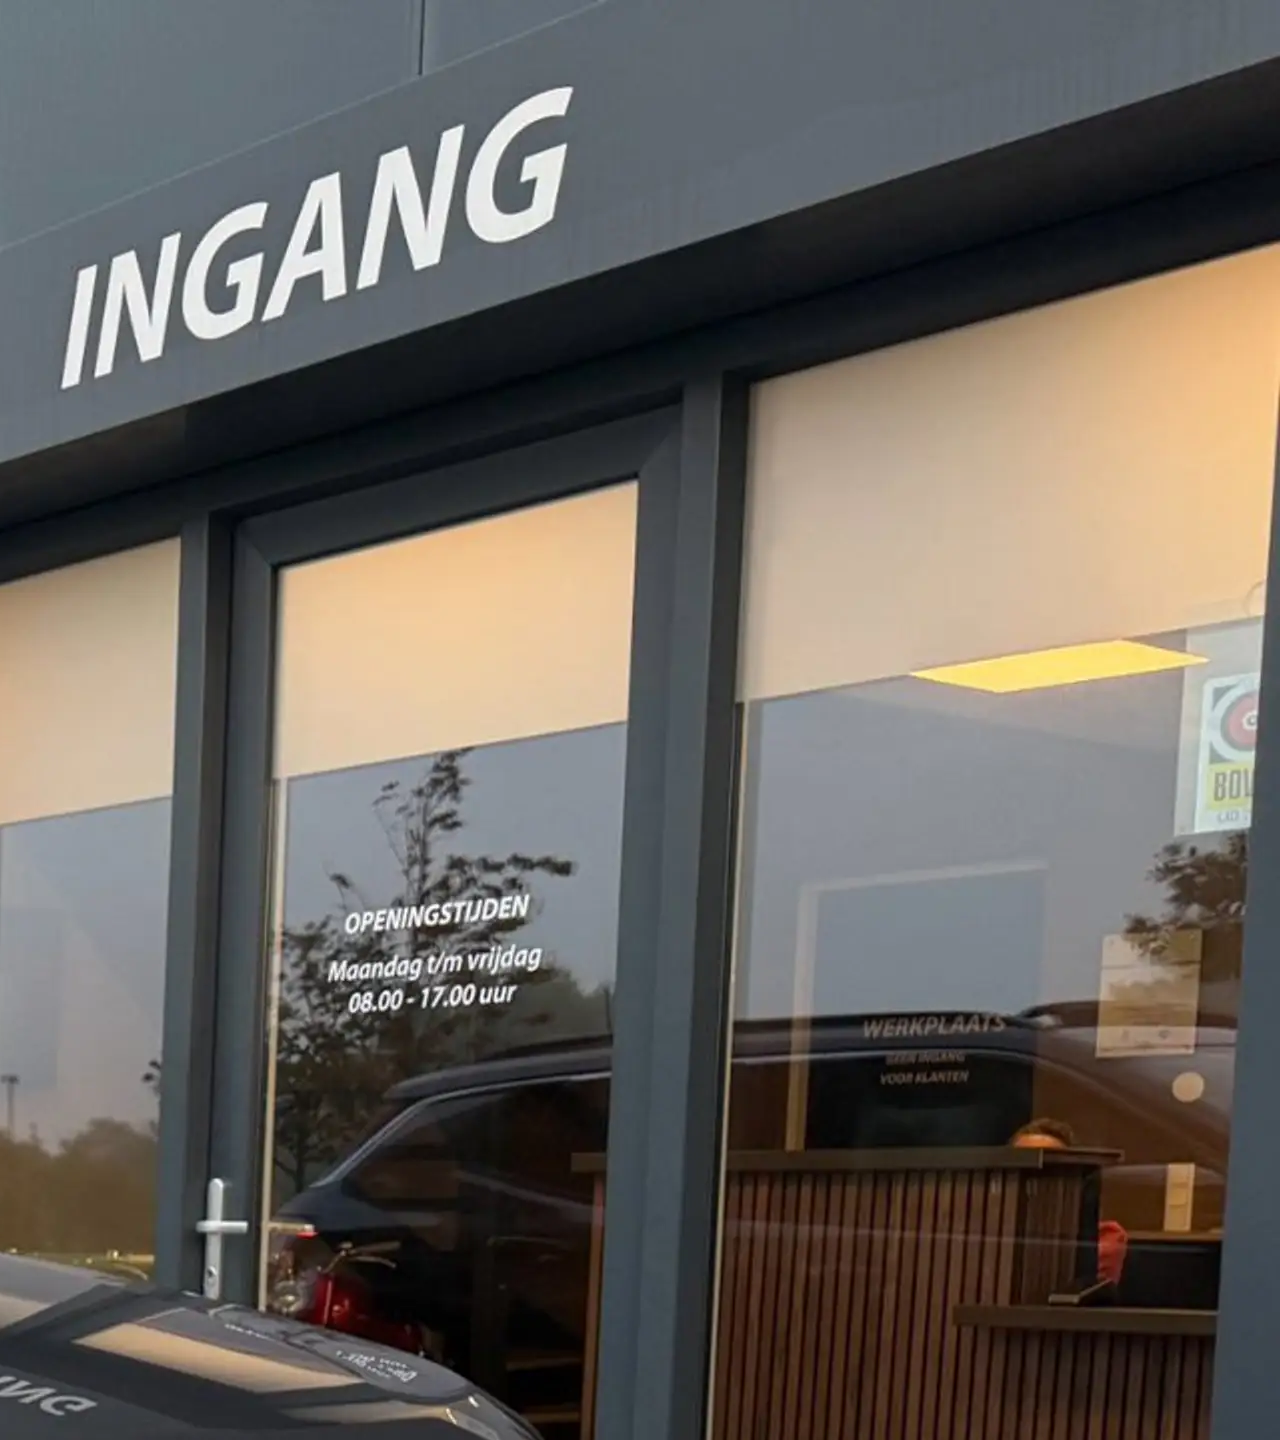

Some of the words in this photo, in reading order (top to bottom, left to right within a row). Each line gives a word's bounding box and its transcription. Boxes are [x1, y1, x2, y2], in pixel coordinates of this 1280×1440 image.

[61, 86, 573, 389] INGANG
[344, 894, 531, 935] OPENINGSTIJDEN
[328, 959, 421, 983] Maandag
[427, 950, 462, 975] t/m
[467, 944, 543, 973] vrijdag
[348, 989, 404, 1014] 08.00
[421, 984, 476, 1009] 17.00
[479, 982, 518, 1004] uur
[863, 1013, 1007, 1039] WERKPLAATS
